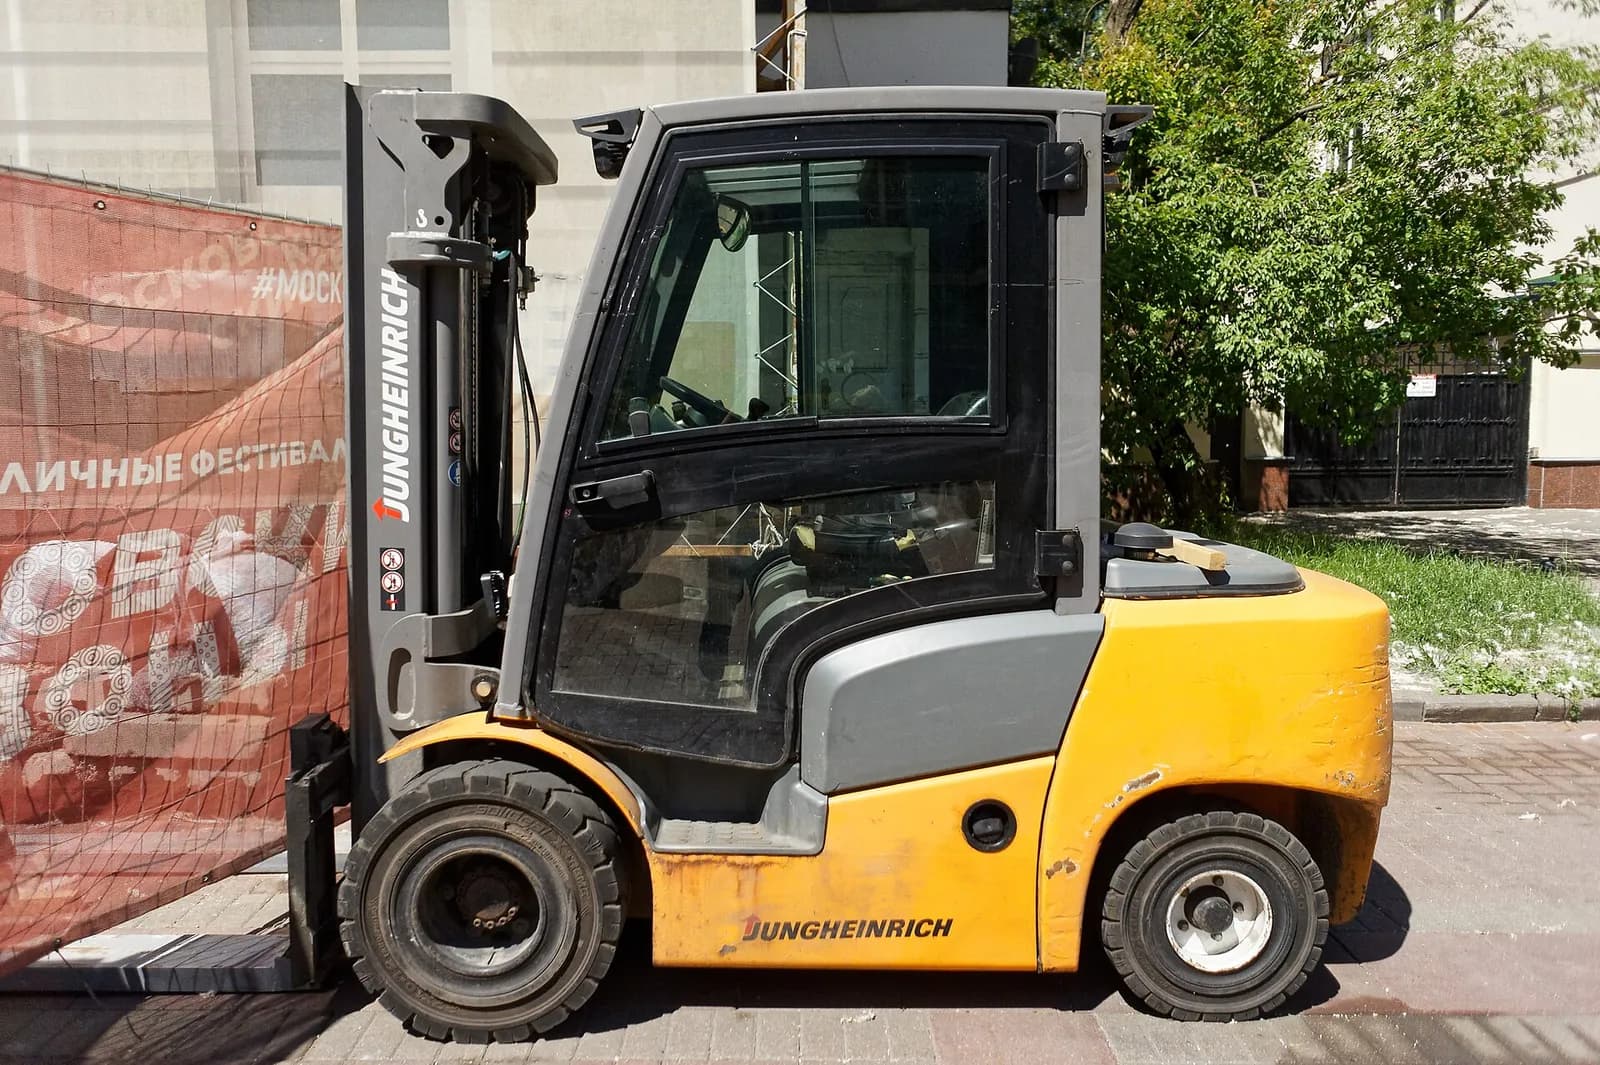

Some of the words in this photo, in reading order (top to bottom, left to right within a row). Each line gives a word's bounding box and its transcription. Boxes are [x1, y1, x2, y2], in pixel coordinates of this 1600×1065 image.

[379, 267, 410, 523] JUNGHEINRICH
[0, 453, 183, 494] ЛИЧНЫЕ
[742, 915, 954, 942] JUNGHEINRICH
